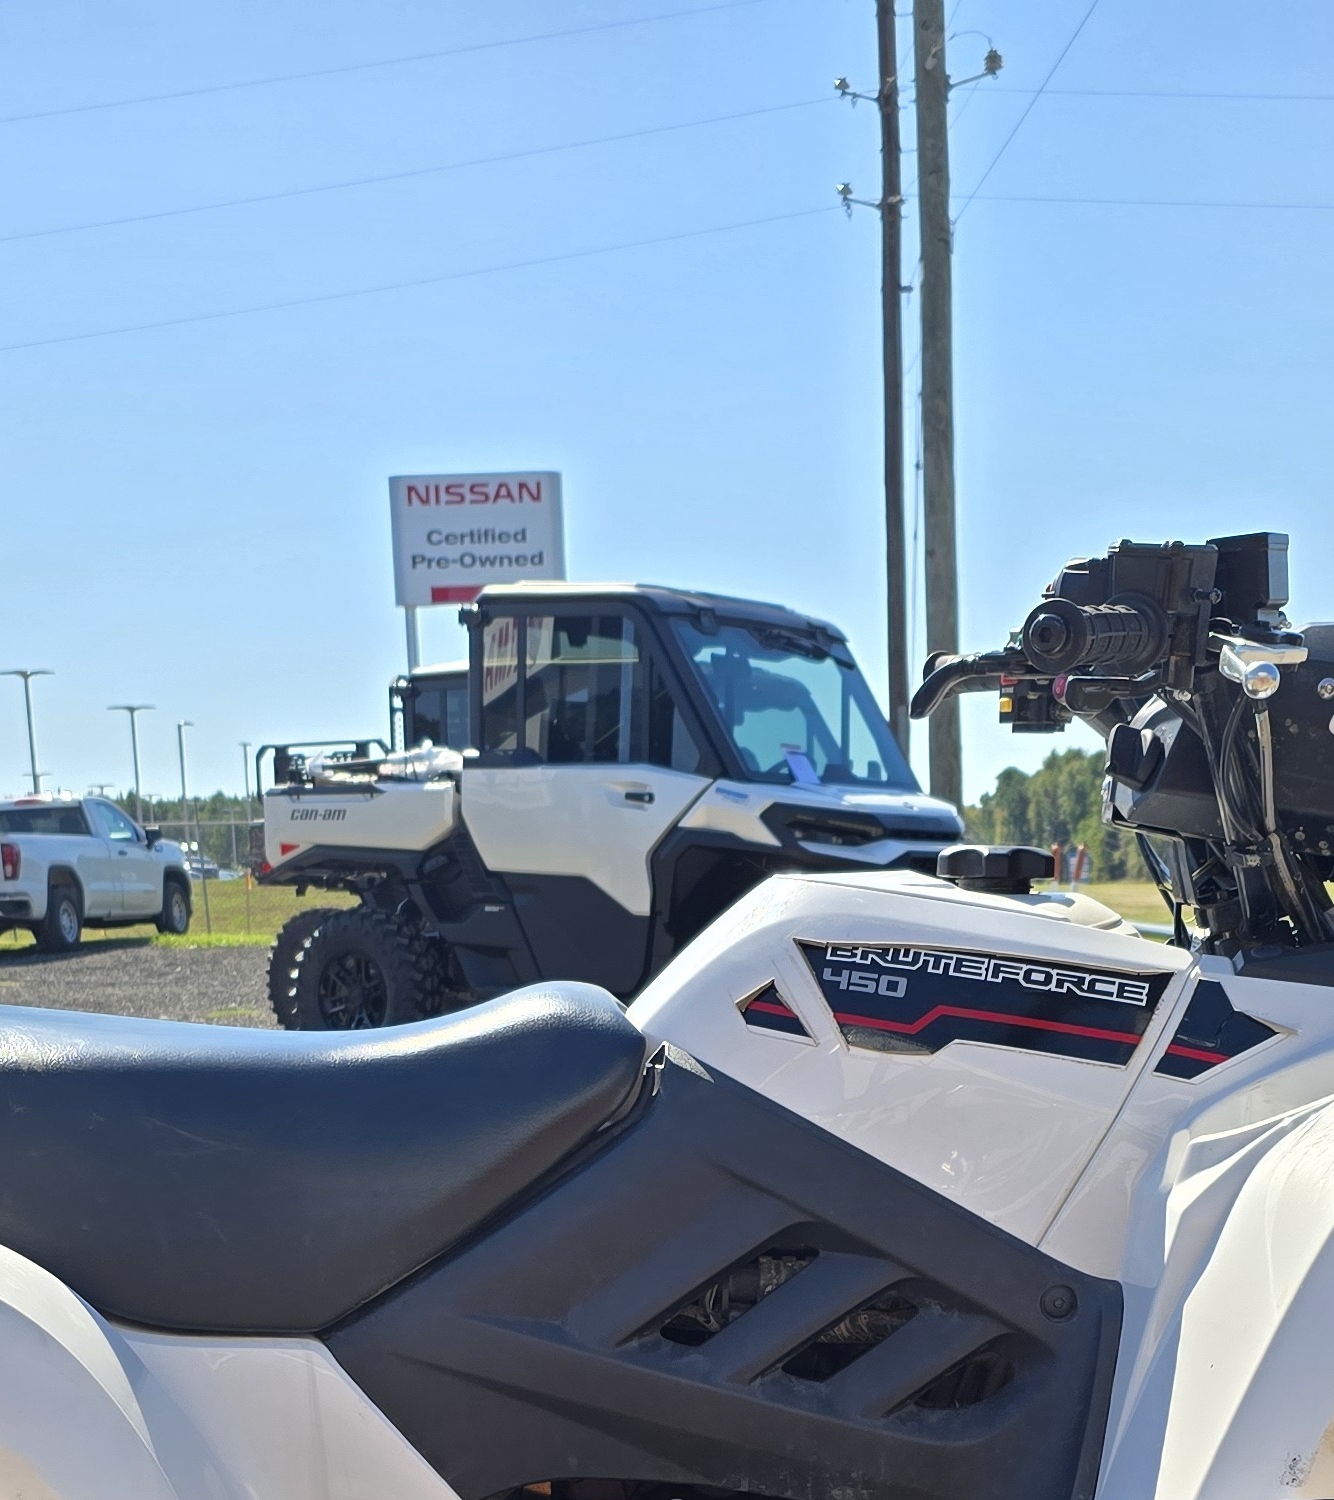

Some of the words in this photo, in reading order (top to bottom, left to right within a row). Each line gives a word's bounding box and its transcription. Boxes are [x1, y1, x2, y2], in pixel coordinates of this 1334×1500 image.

[407, 480, 542, 507] NISSAN
[426, 528, 527, 546] Certified
[411, 551, 544, 570] Pre-Owned
[290, 808, 347, 821] can-am
[823, 967, 908, 998] 450
